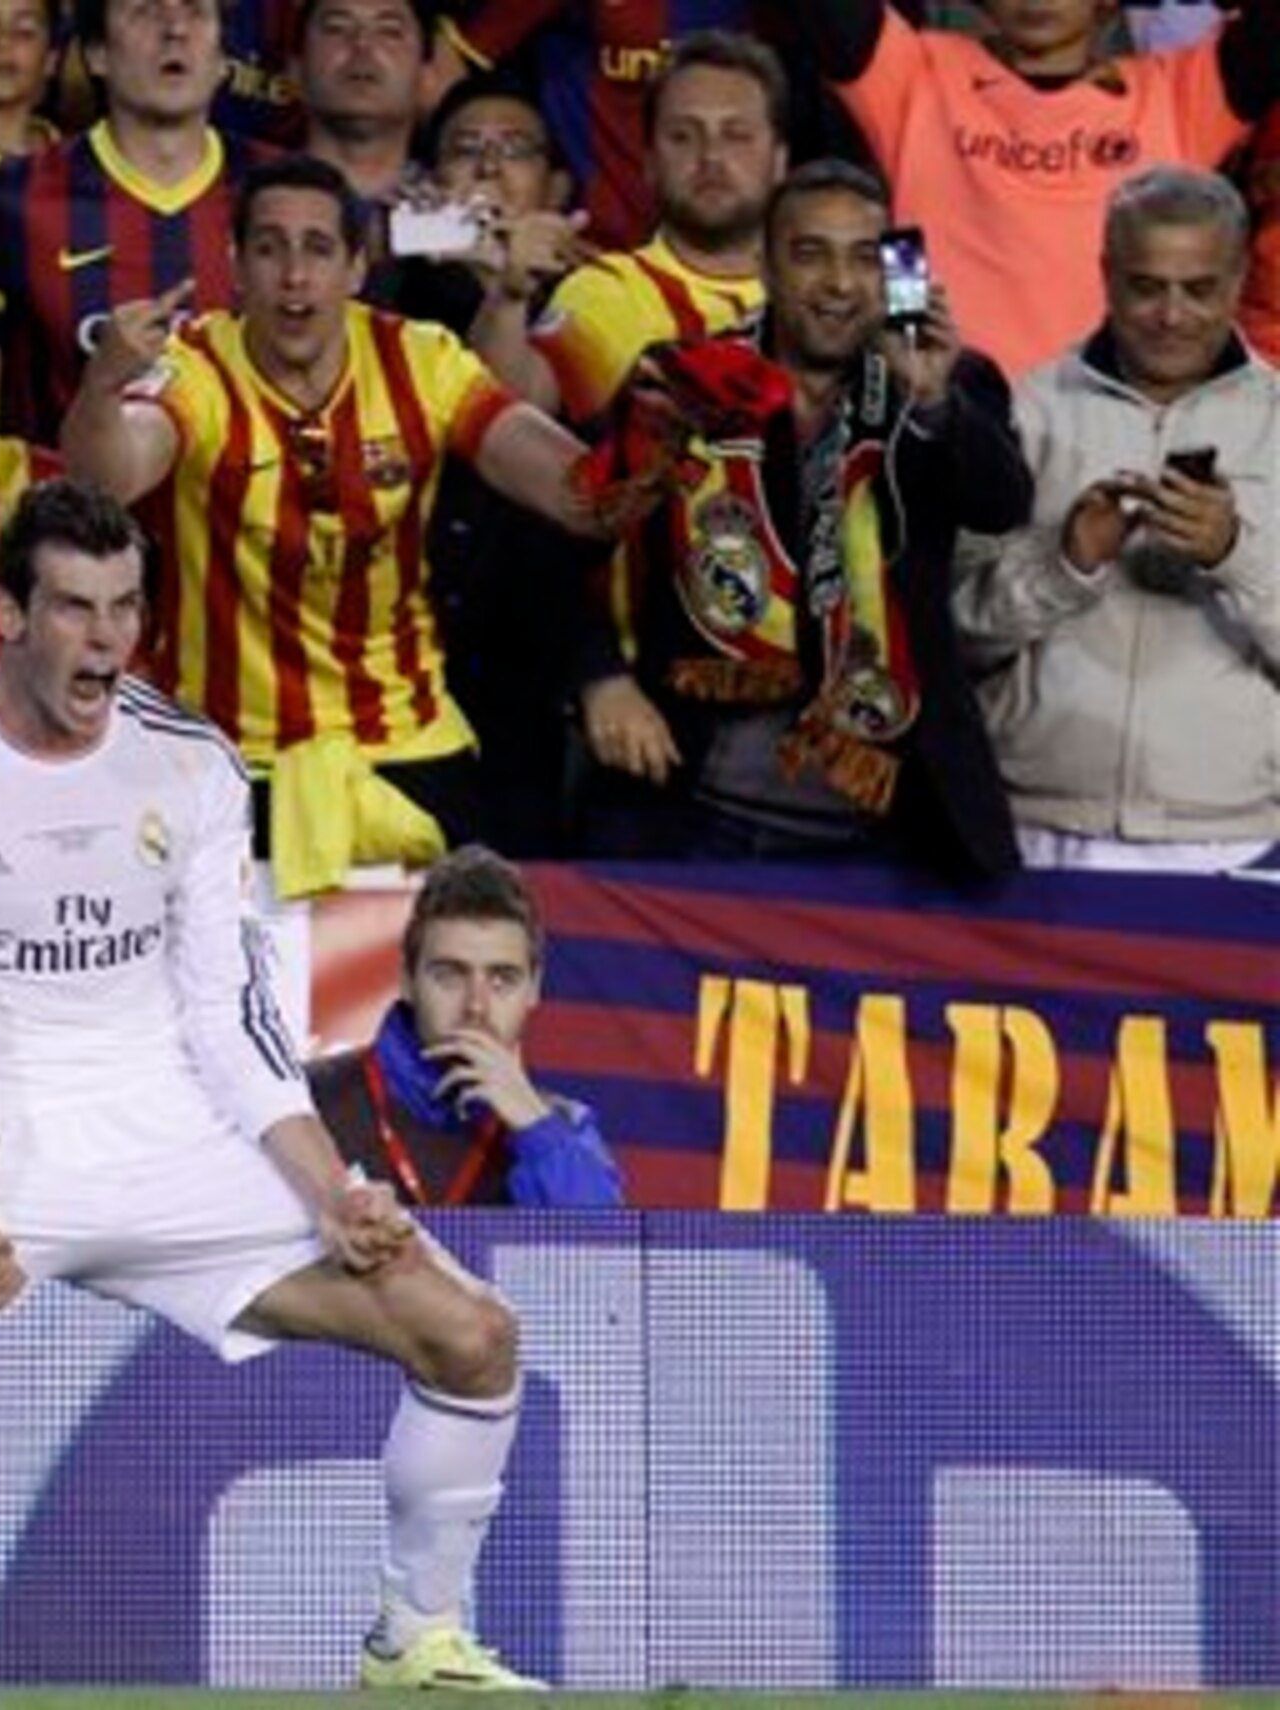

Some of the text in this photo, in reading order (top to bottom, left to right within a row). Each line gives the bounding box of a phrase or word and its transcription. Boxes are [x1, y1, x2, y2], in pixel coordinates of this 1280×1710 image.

[599, 39, 676, 80] uni
[953, 125, 1086, 173] unicef
[56, 893, 112, 928] Fly
